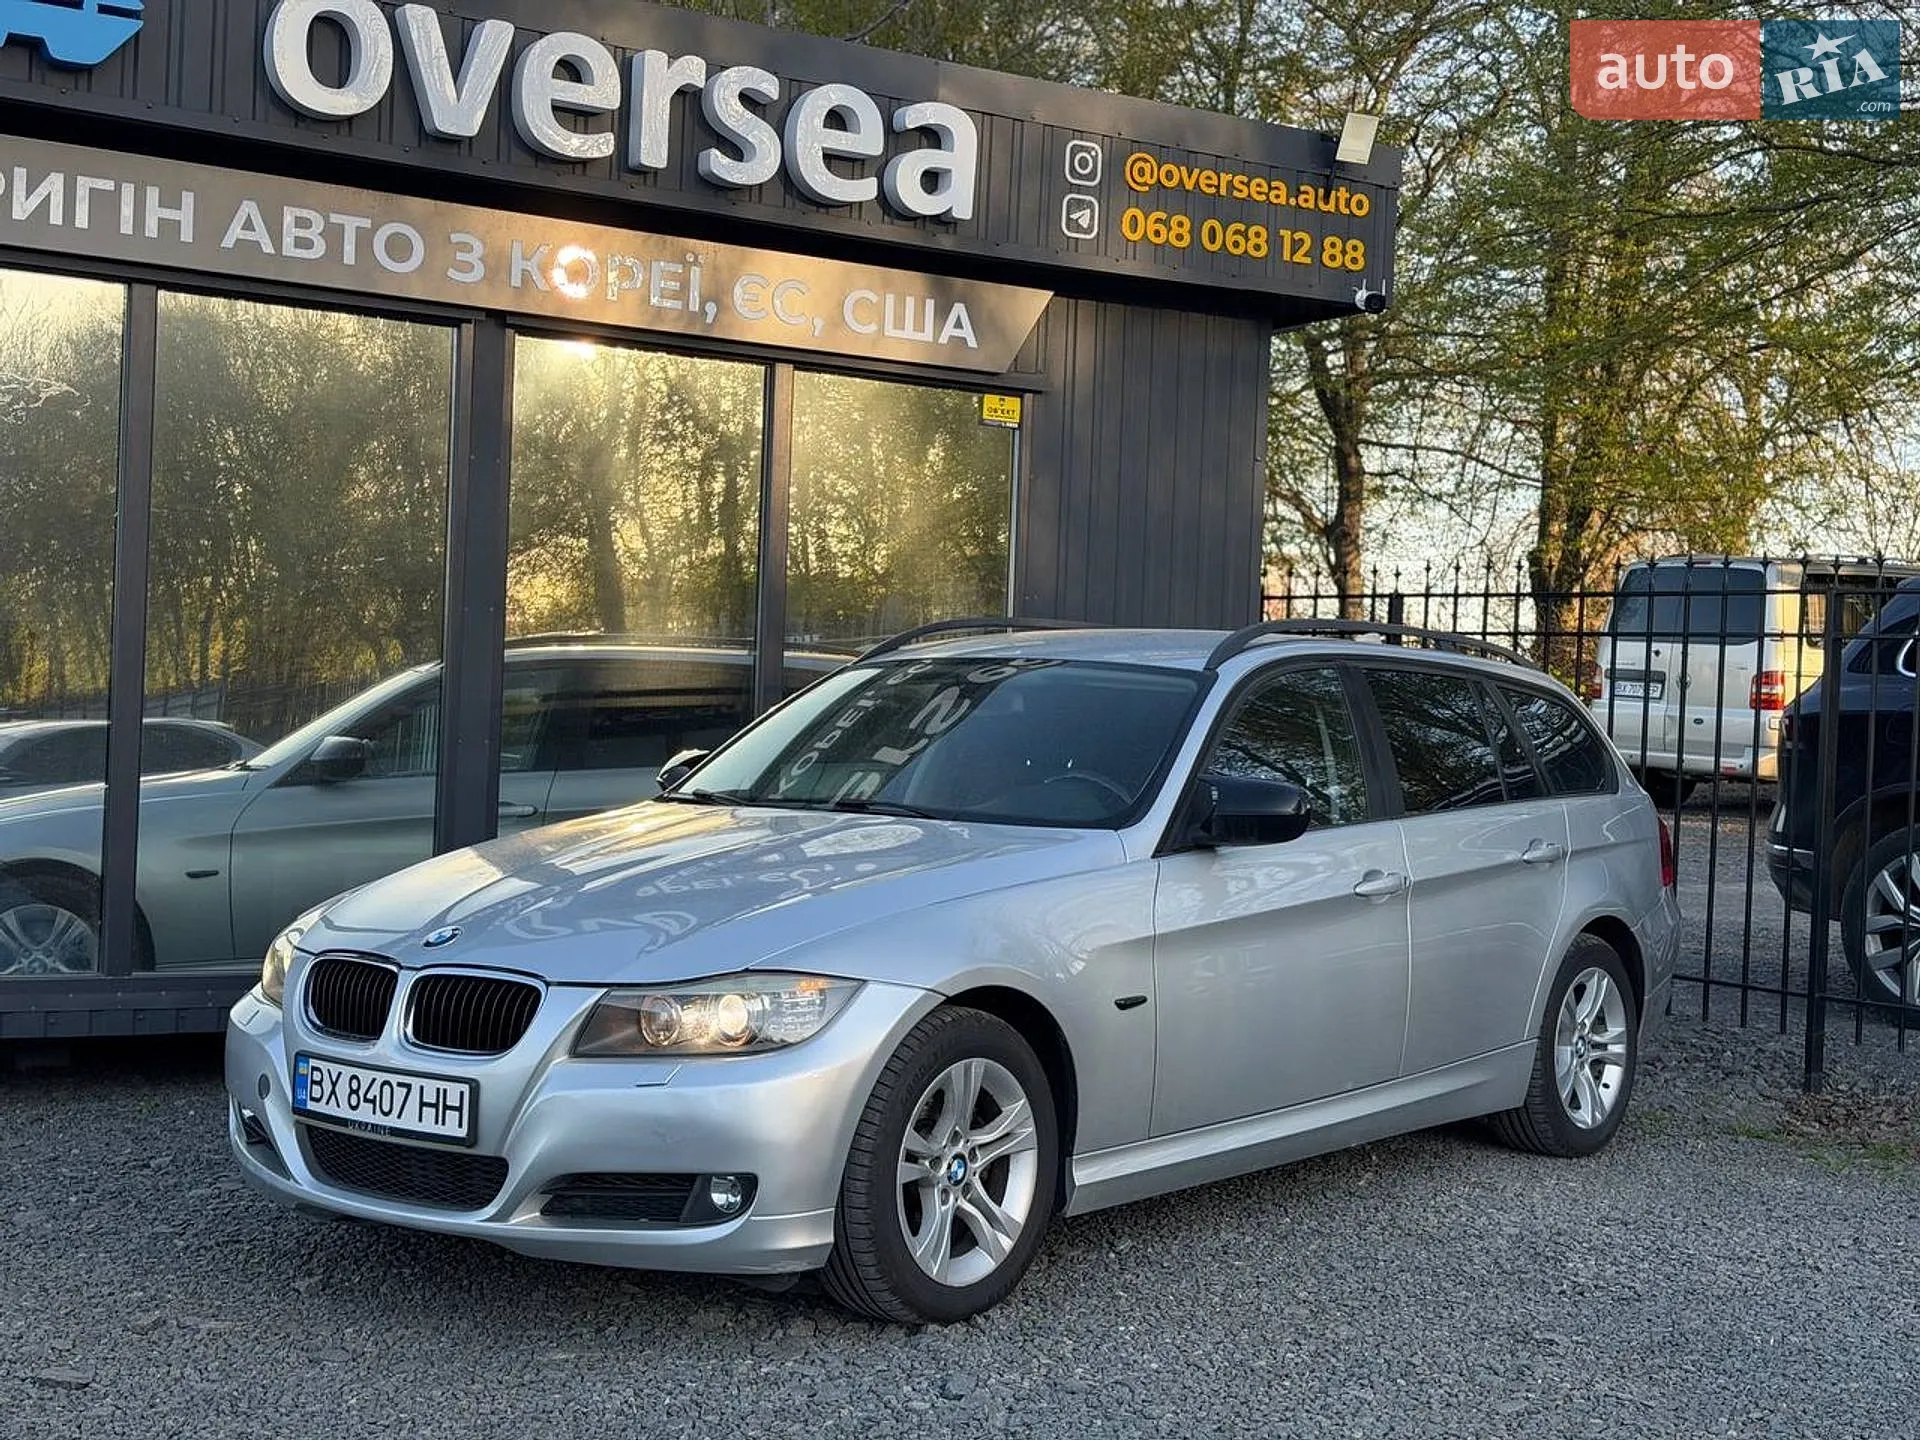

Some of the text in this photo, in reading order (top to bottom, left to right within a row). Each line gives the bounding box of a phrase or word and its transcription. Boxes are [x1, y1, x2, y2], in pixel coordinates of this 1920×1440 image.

[263, 0, 978, 221] oversea
[1124, 152, 1370, 217] @oversea.auto
[0, 165, 195, 243] ИГІН
[220, 199, 426, 274] АВТО
[510, 239, 718, 325] КОРЕЇ,
[733, 273, 824, 338] ЄС,
[843, 289, 979, 349] США
[1121, 207, 1367, 272] 068 068 12 88
[309, 1065, 465, 1129] BX 8407 HH
